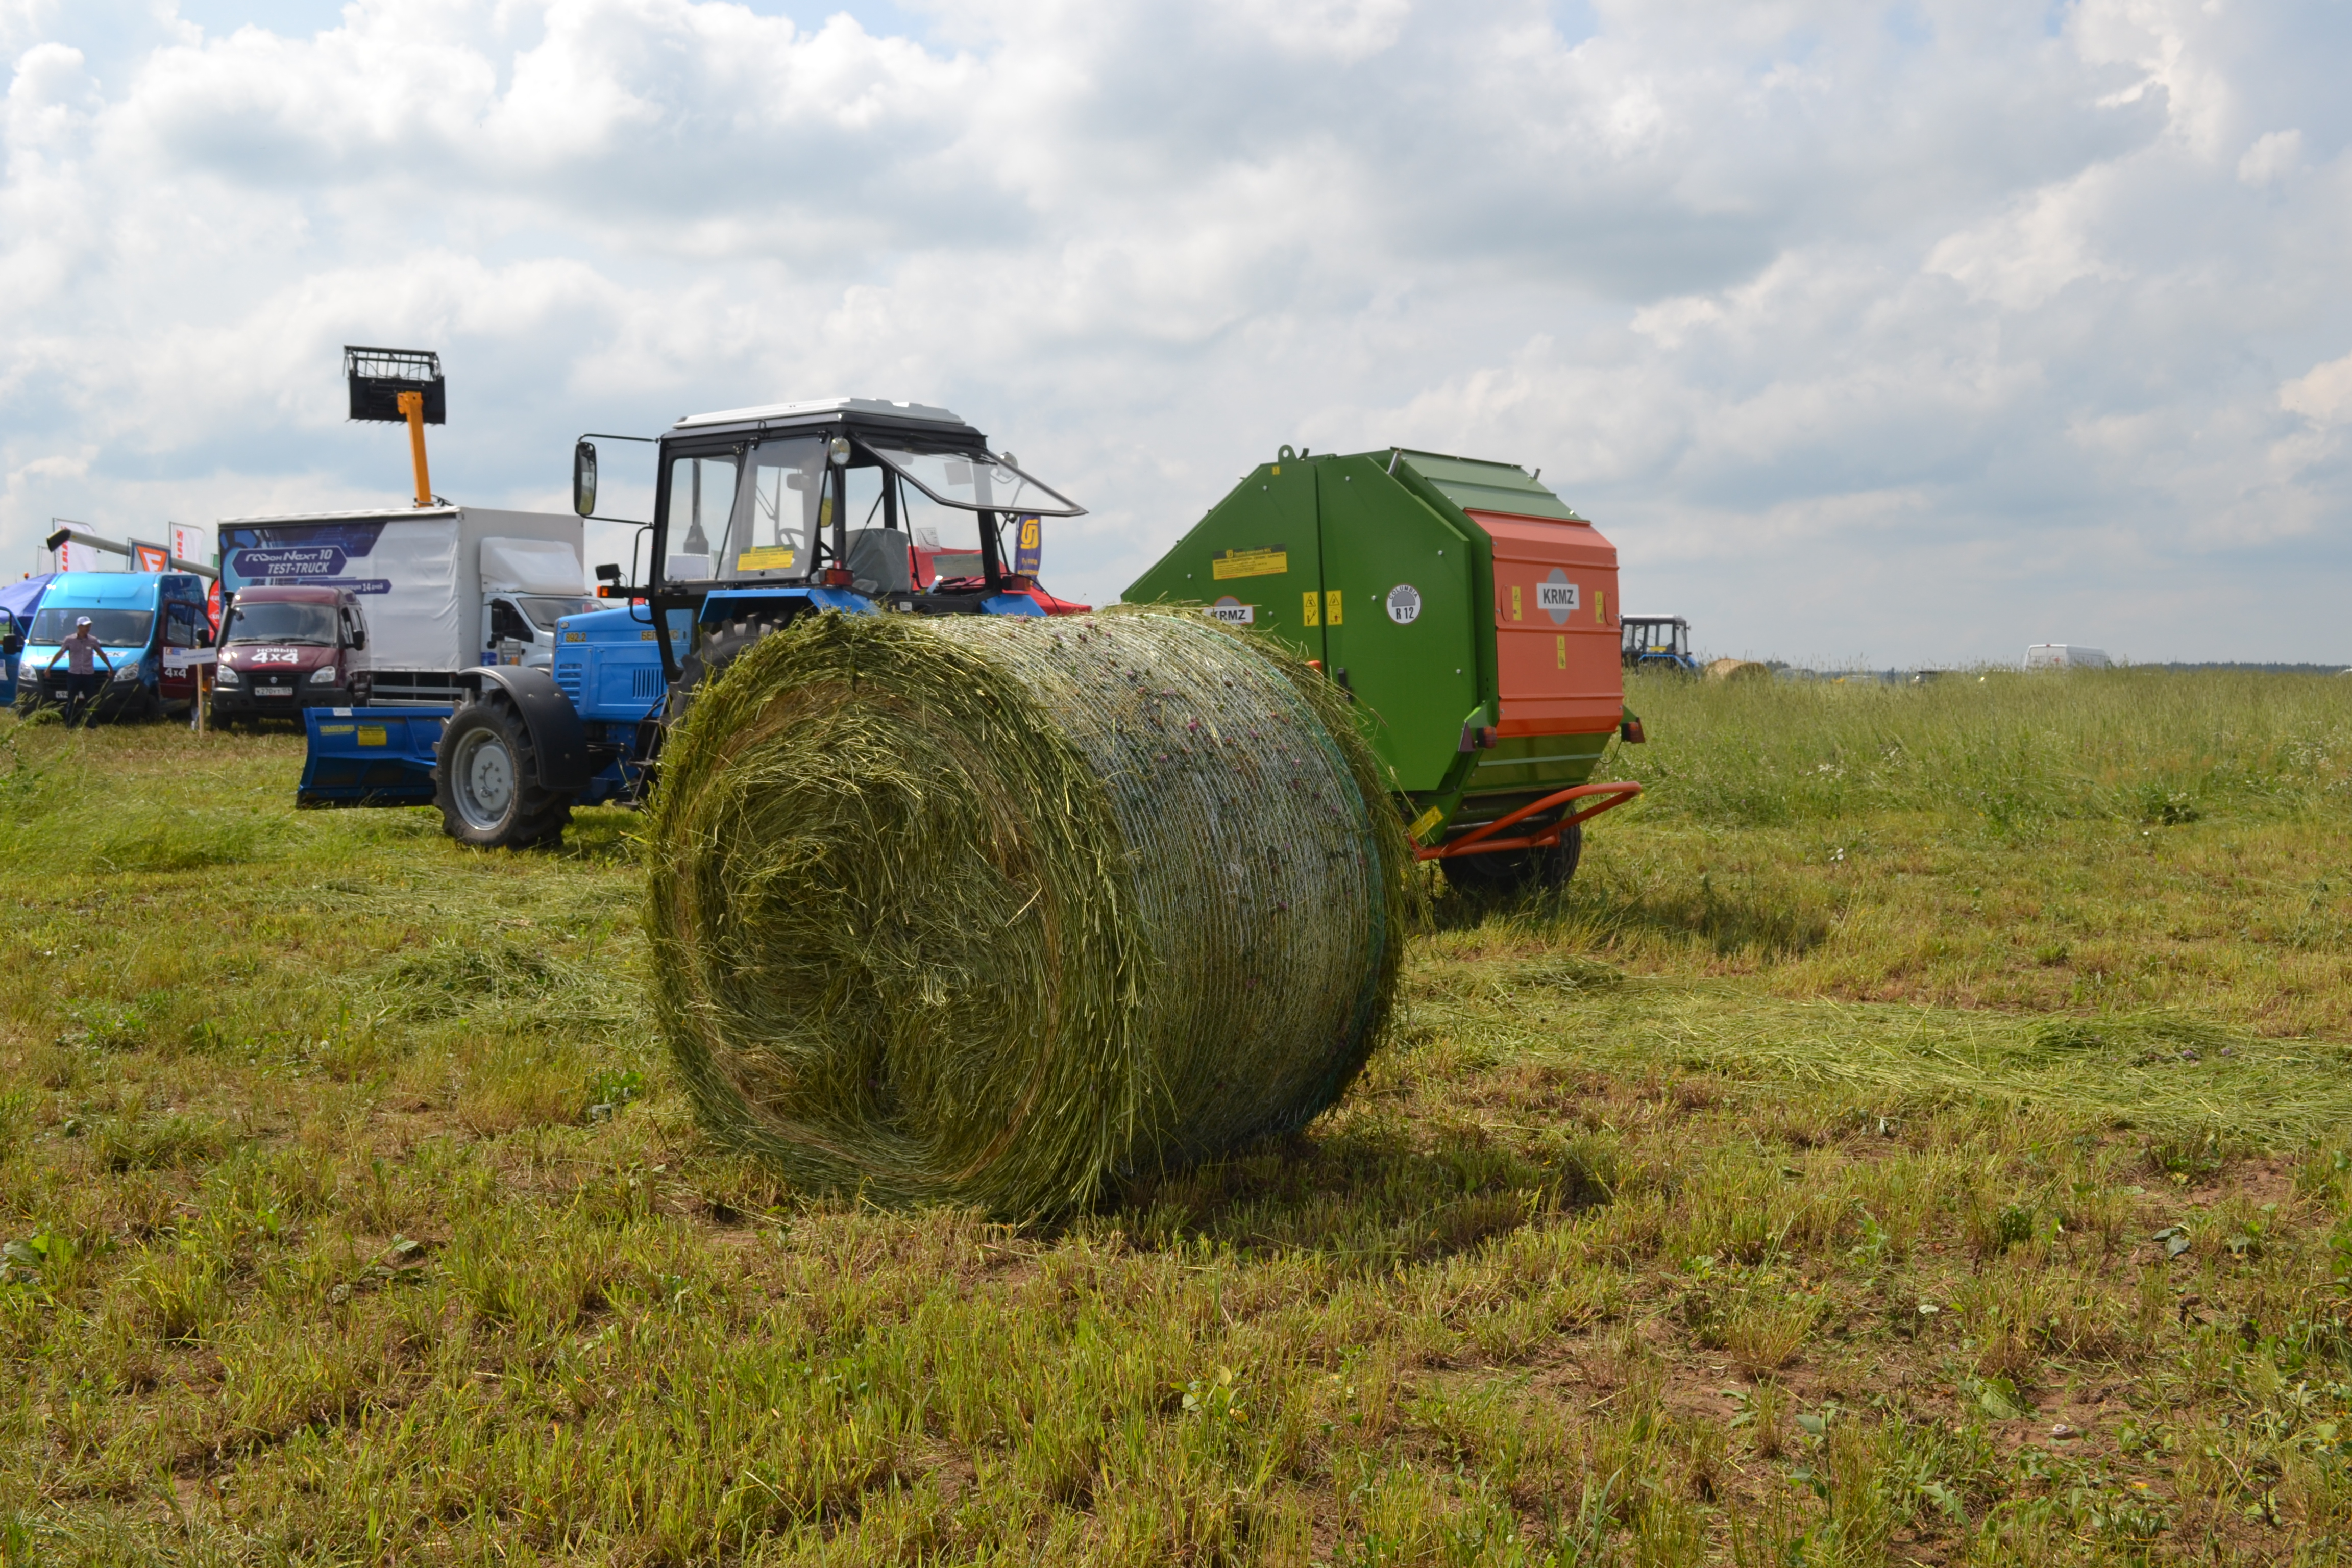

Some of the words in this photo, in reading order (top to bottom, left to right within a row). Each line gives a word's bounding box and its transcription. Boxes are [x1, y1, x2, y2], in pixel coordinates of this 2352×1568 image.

[319, 549, 333, 560] 10
[268, 562, 329, 574] TEST-TRUCK
[362, 583, 371, 591] 14
[1389, 585, 1418, 600] COLUMBIA
[1543, 588, 1574, 605] KRMZ
[1395, 608, 1401, 620] R
[1404, 607, 1414, 619] 12
